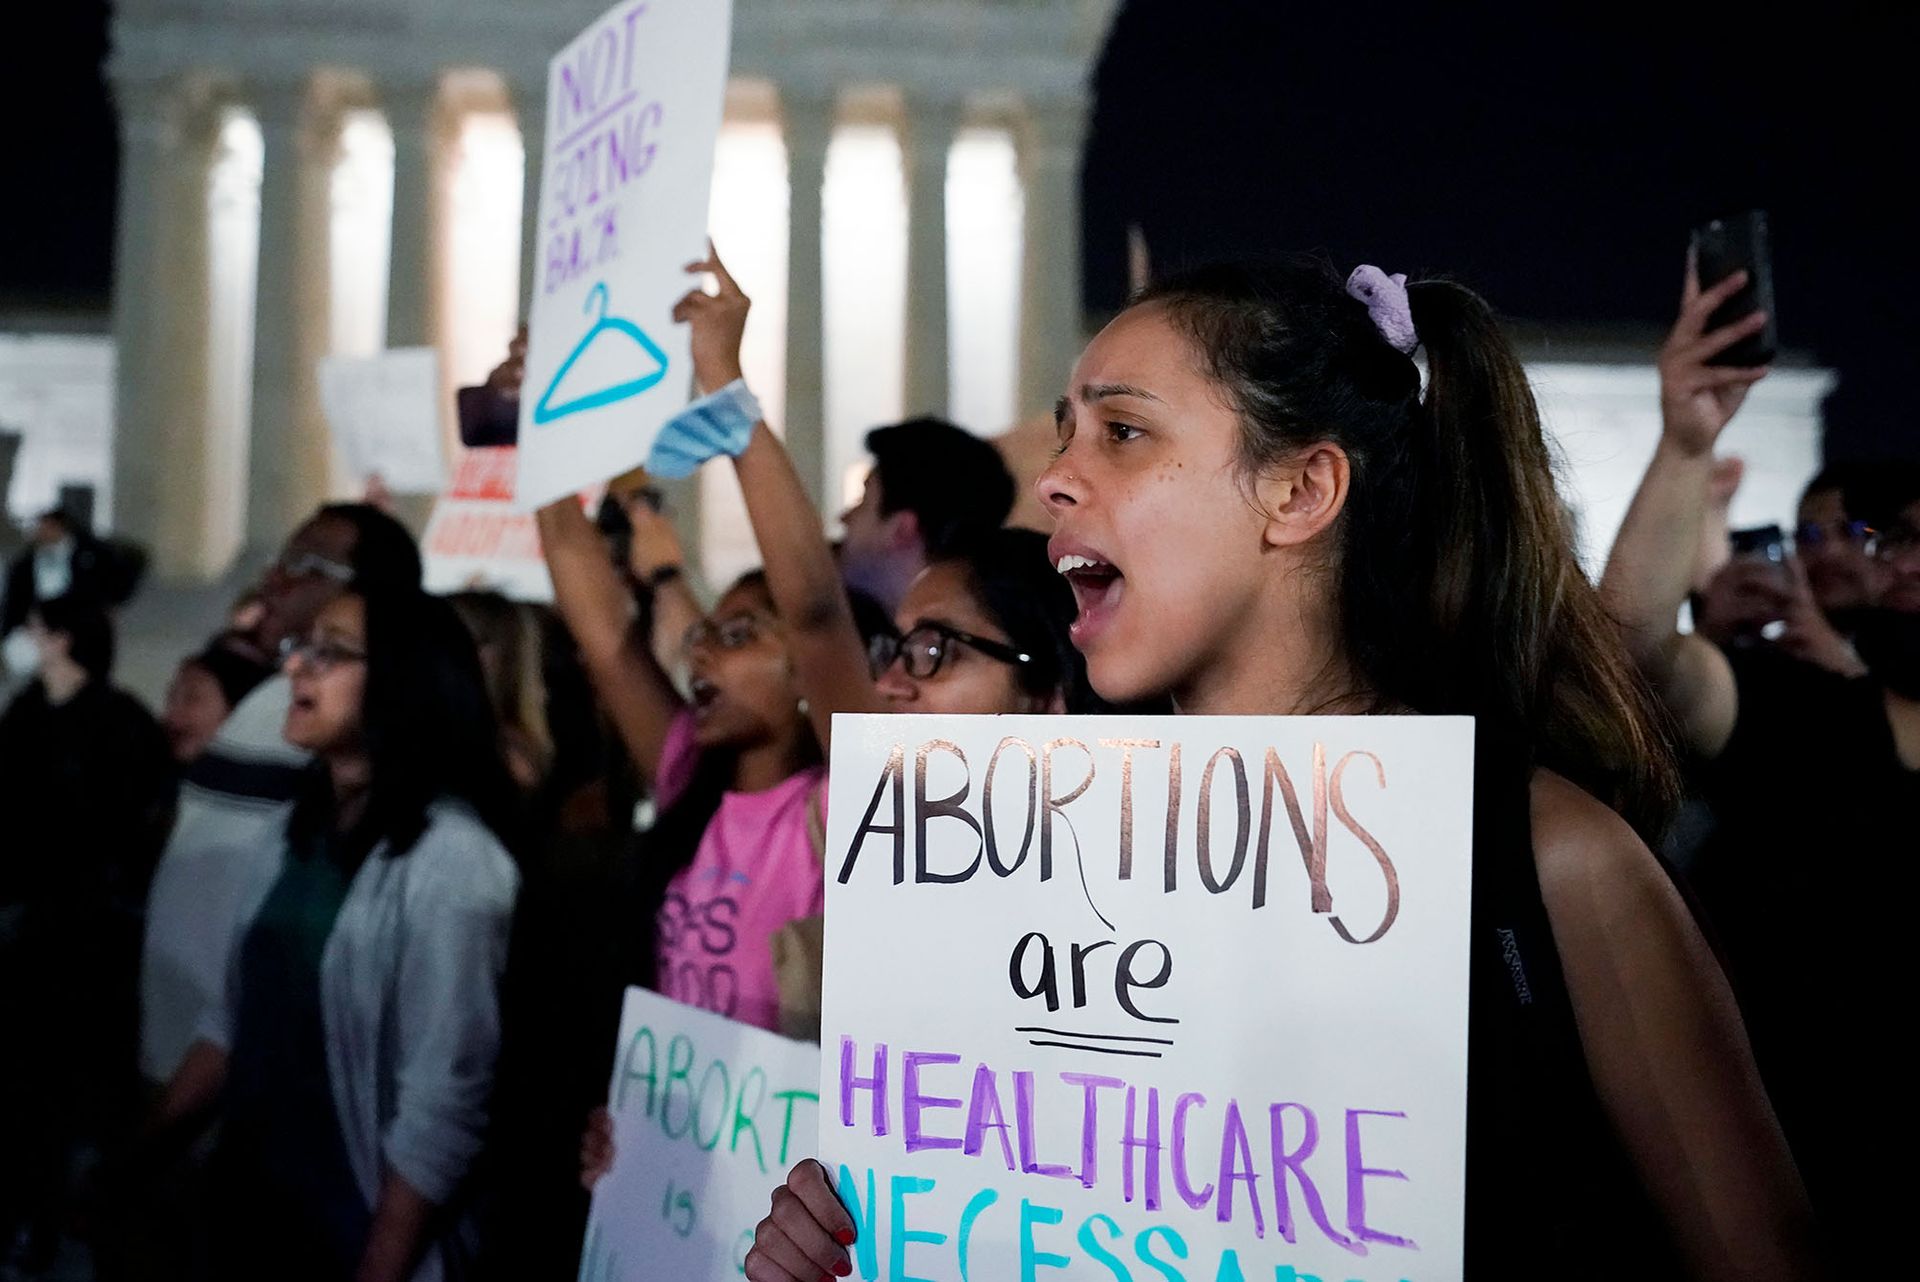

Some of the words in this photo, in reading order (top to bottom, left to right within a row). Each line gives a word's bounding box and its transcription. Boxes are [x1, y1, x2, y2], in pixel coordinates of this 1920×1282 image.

[556, 2, 649, 132] NOT
[837, 735, 1401, 945] ABORTIONS
[1008, 931, 1180, 1024] are
[839, 1034, 1421, 1257] HEALTHCARE
[838, 1162, 1414, 1282] NECESS
